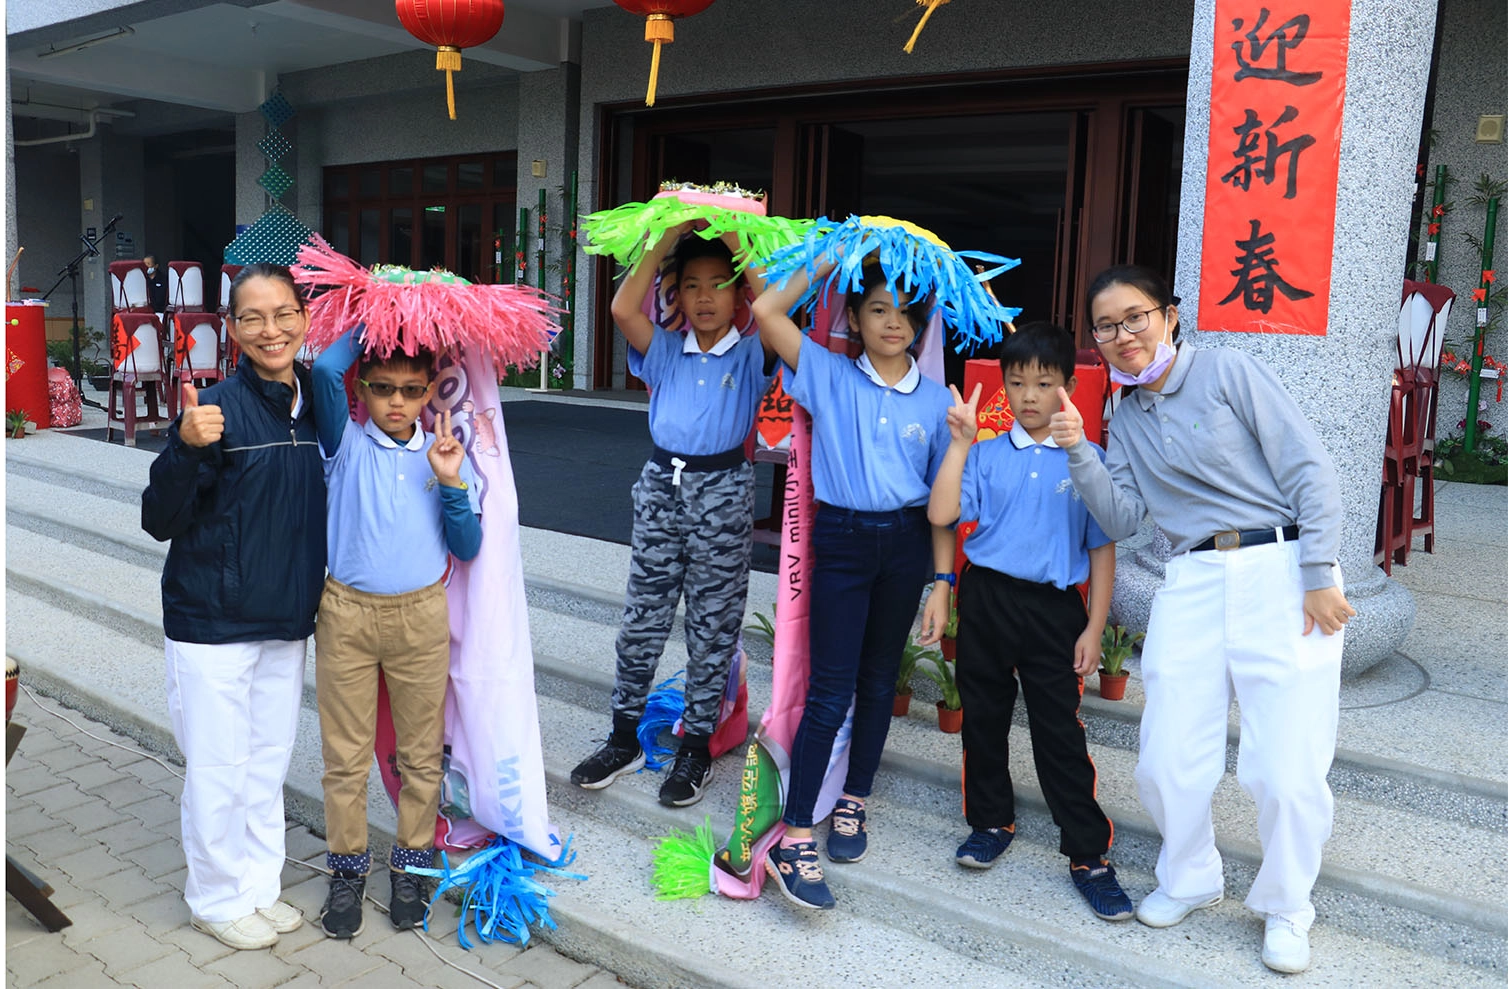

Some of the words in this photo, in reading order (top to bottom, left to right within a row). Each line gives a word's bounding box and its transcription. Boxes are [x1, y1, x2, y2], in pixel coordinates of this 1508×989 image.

[1218, 7, 1324, 315] 迎新春
[787, 554, 802, 601] VRV
